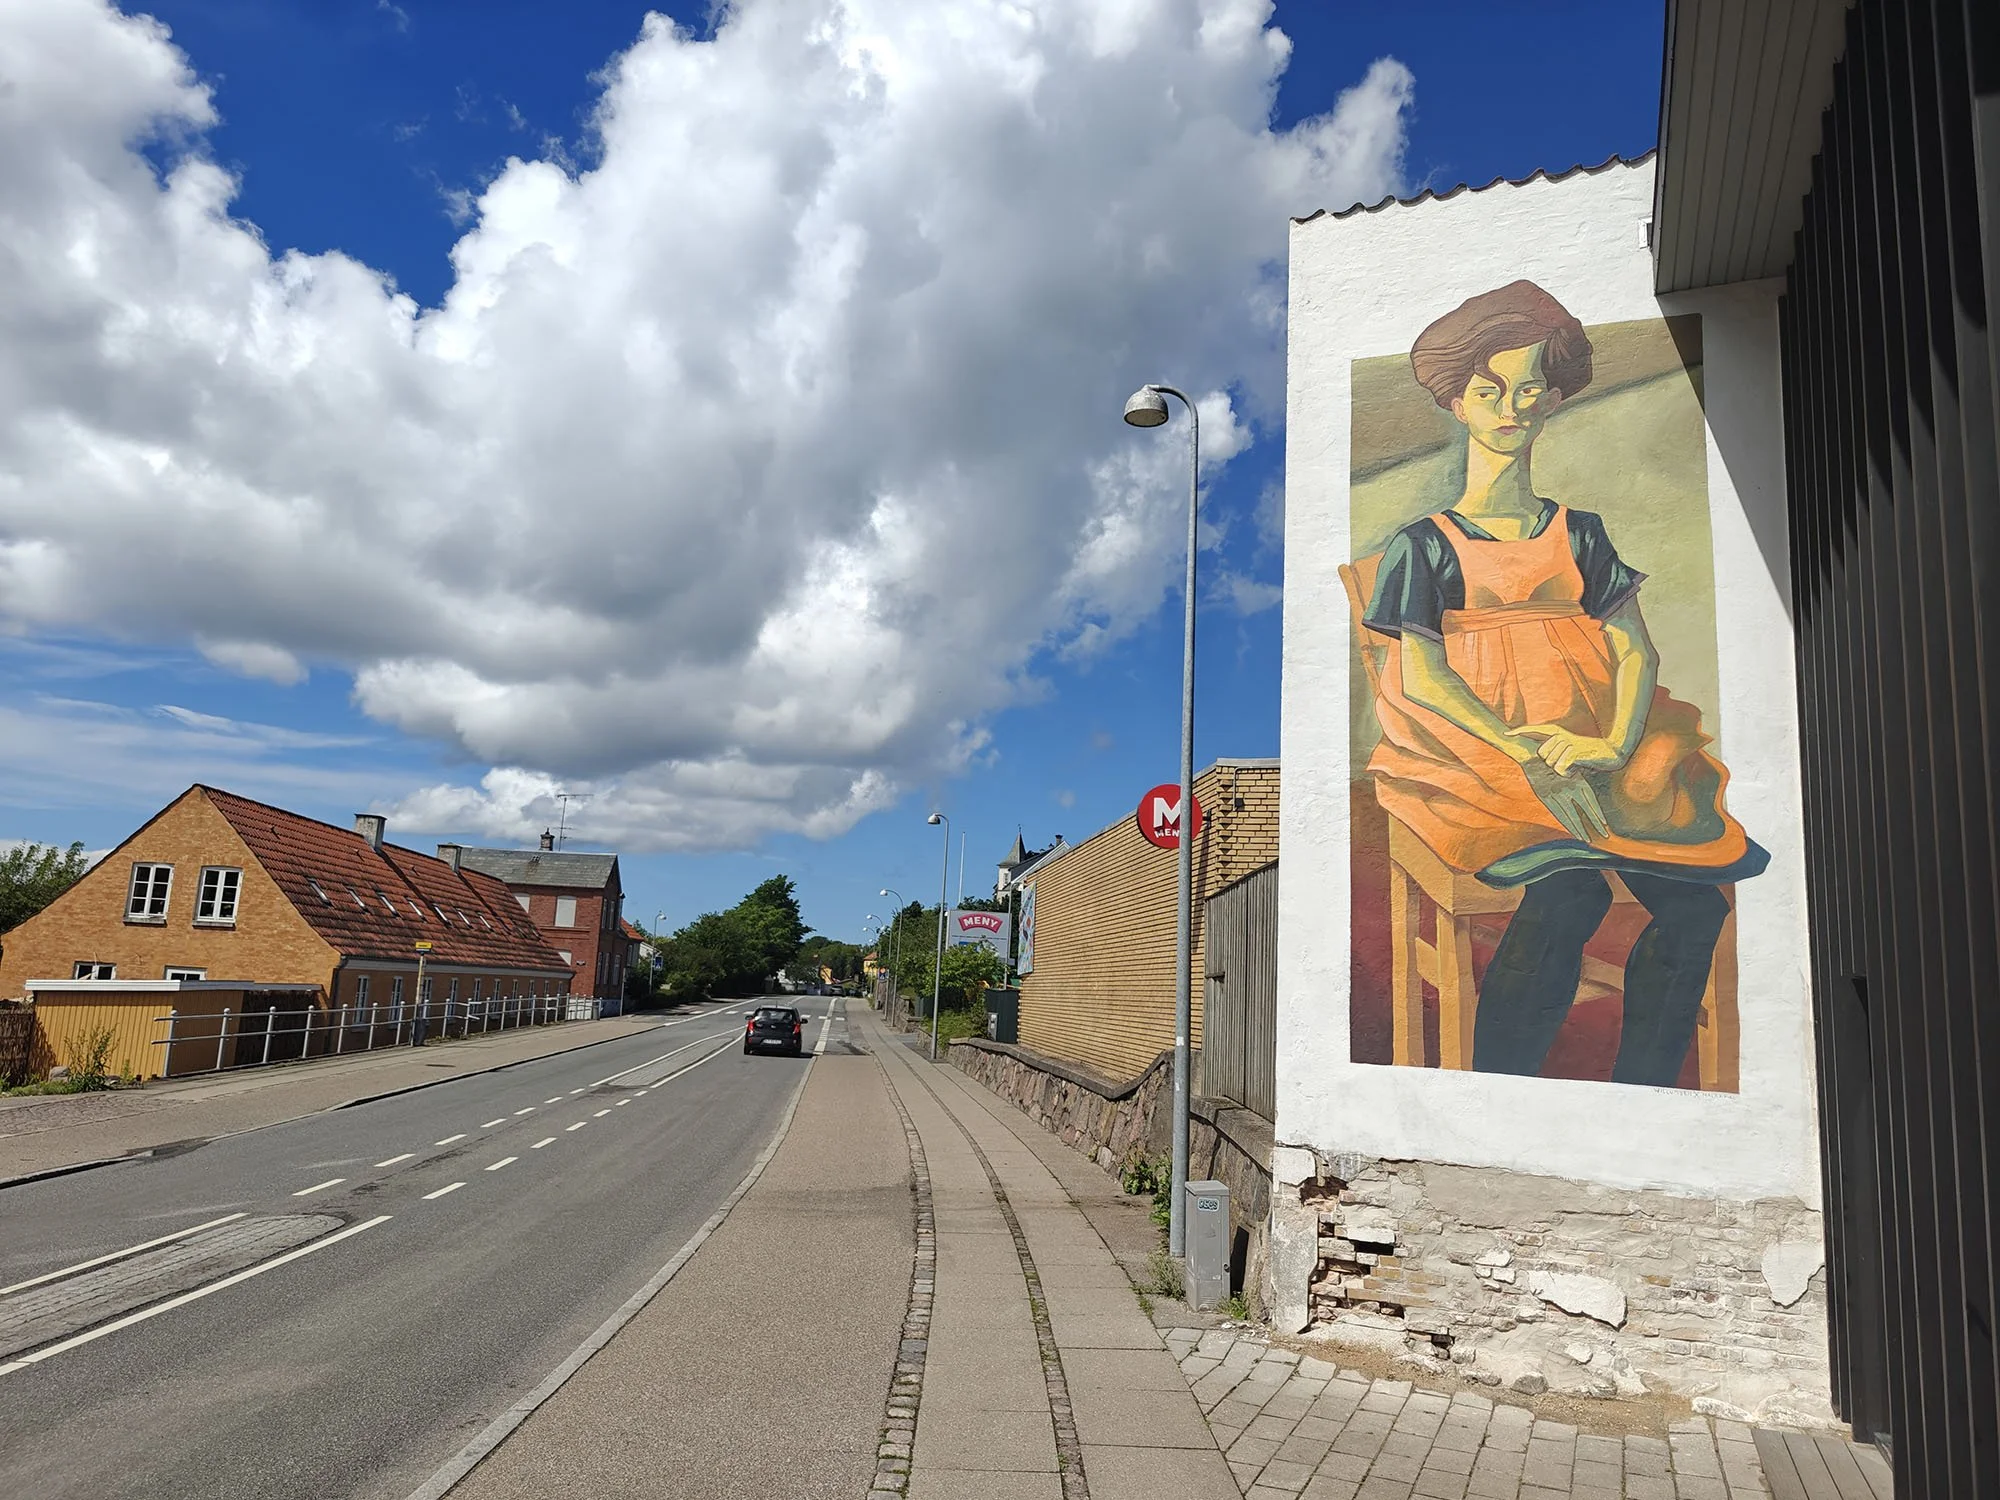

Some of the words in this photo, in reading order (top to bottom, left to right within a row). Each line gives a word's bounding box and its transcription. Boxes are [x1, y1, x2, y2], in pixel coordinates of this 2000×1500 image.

[1153, 797, 1181, 828] M
[1154, 828, 1180, 838] MEN
[963, 916, 998, 928] MENY
